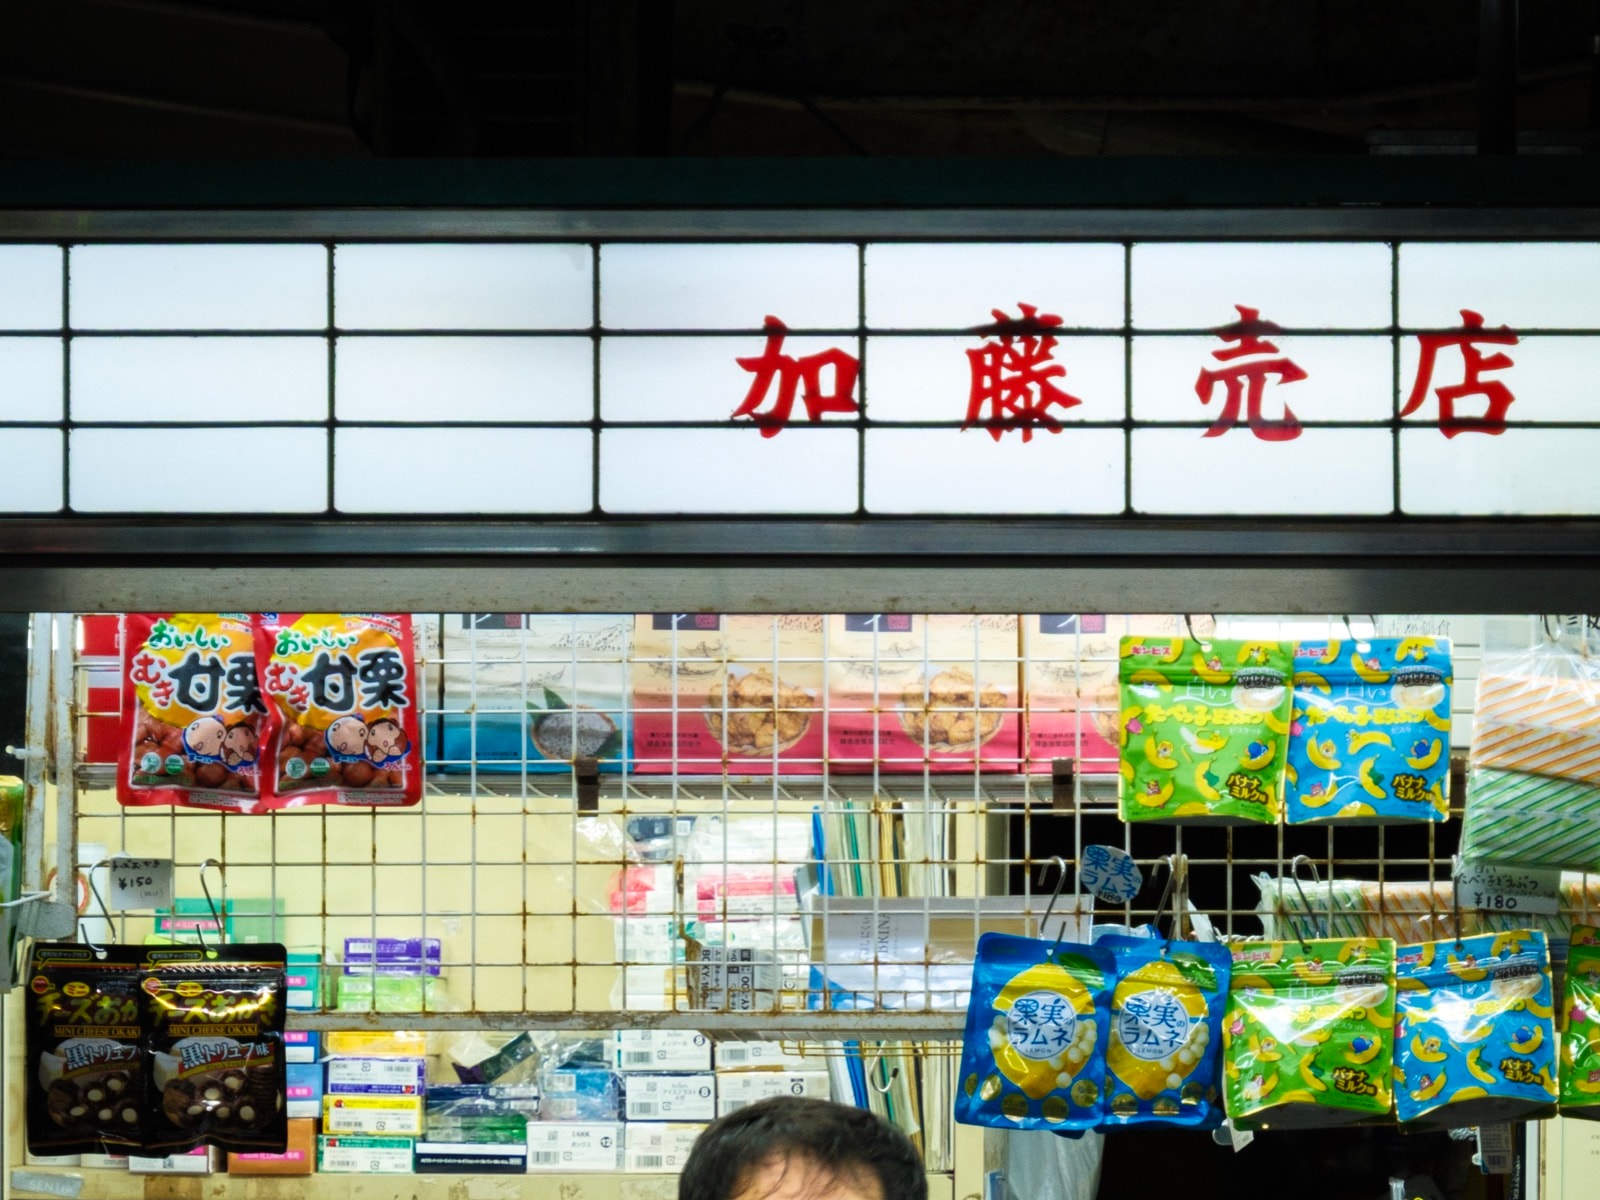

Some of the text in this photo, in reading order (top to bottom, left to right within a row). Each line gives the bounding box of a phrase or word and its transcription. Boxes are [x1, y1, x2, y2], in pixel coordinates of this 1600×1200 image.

[731, 302, 1519, 442] 加藤売店
[149, 618, 231, 651] おいしい
[275, 625, 358, 657] おいしい
[131, 652, 174, 709] むき
[265, 662, 309, 711] むき
[301, 648, 409, 712] 甘栗
[1227, 774, 1260, 789] バナナ
[1393, 775, 1426, 789] バナナ
[118, 876, 153, 891] ¥150
[1474, 892, 1518, 909] ¥180
[1013, 999, 1072, 1027] 果実の
[1125, 999, 1185, 1027] 果実の
[79, 1026, 110, 1036] CHEESE
[194, 1025, 226, 1035] CHEESE
[1012, 1029, 1072, 1047] ラムネ
[1124, 1029, 1184, 1047] ラムネ
[180, 1042, 269, 1069] 黒トリュフ味
[1333, 1068, 1367, 1081] バナナ
[1501, 1060, 1533, 1071] バナナ
